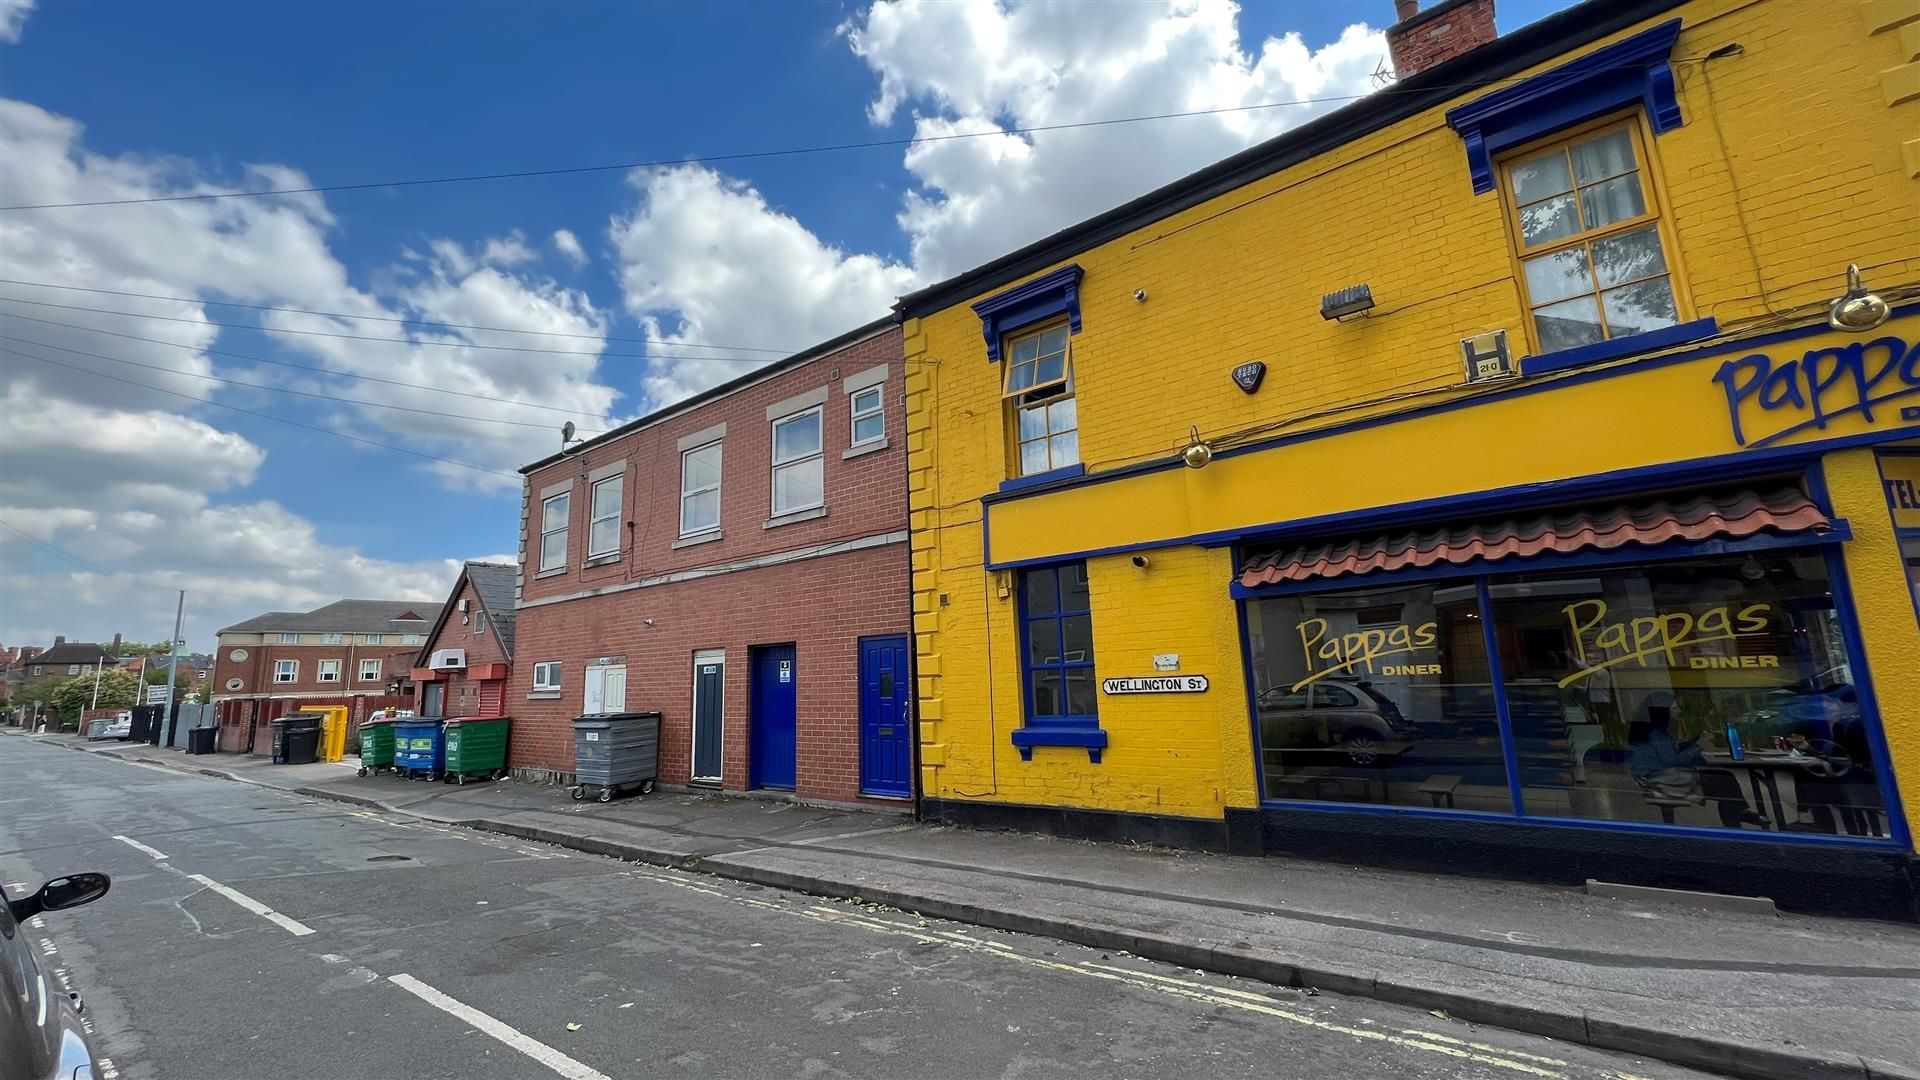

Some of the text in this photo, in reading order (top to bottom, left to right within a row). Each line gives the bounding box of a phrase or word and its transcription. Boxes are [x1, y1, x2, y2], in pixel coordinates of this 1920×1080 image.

[1562, 599, 1771, 673] Pappas
[1294, 618, 1438, 680] Pappas
[1689, 655, 1779, 669] DINER
[1382, 664, 1442, 676] DINER
[1108, 679, 1182, 691] WELLINGTON
